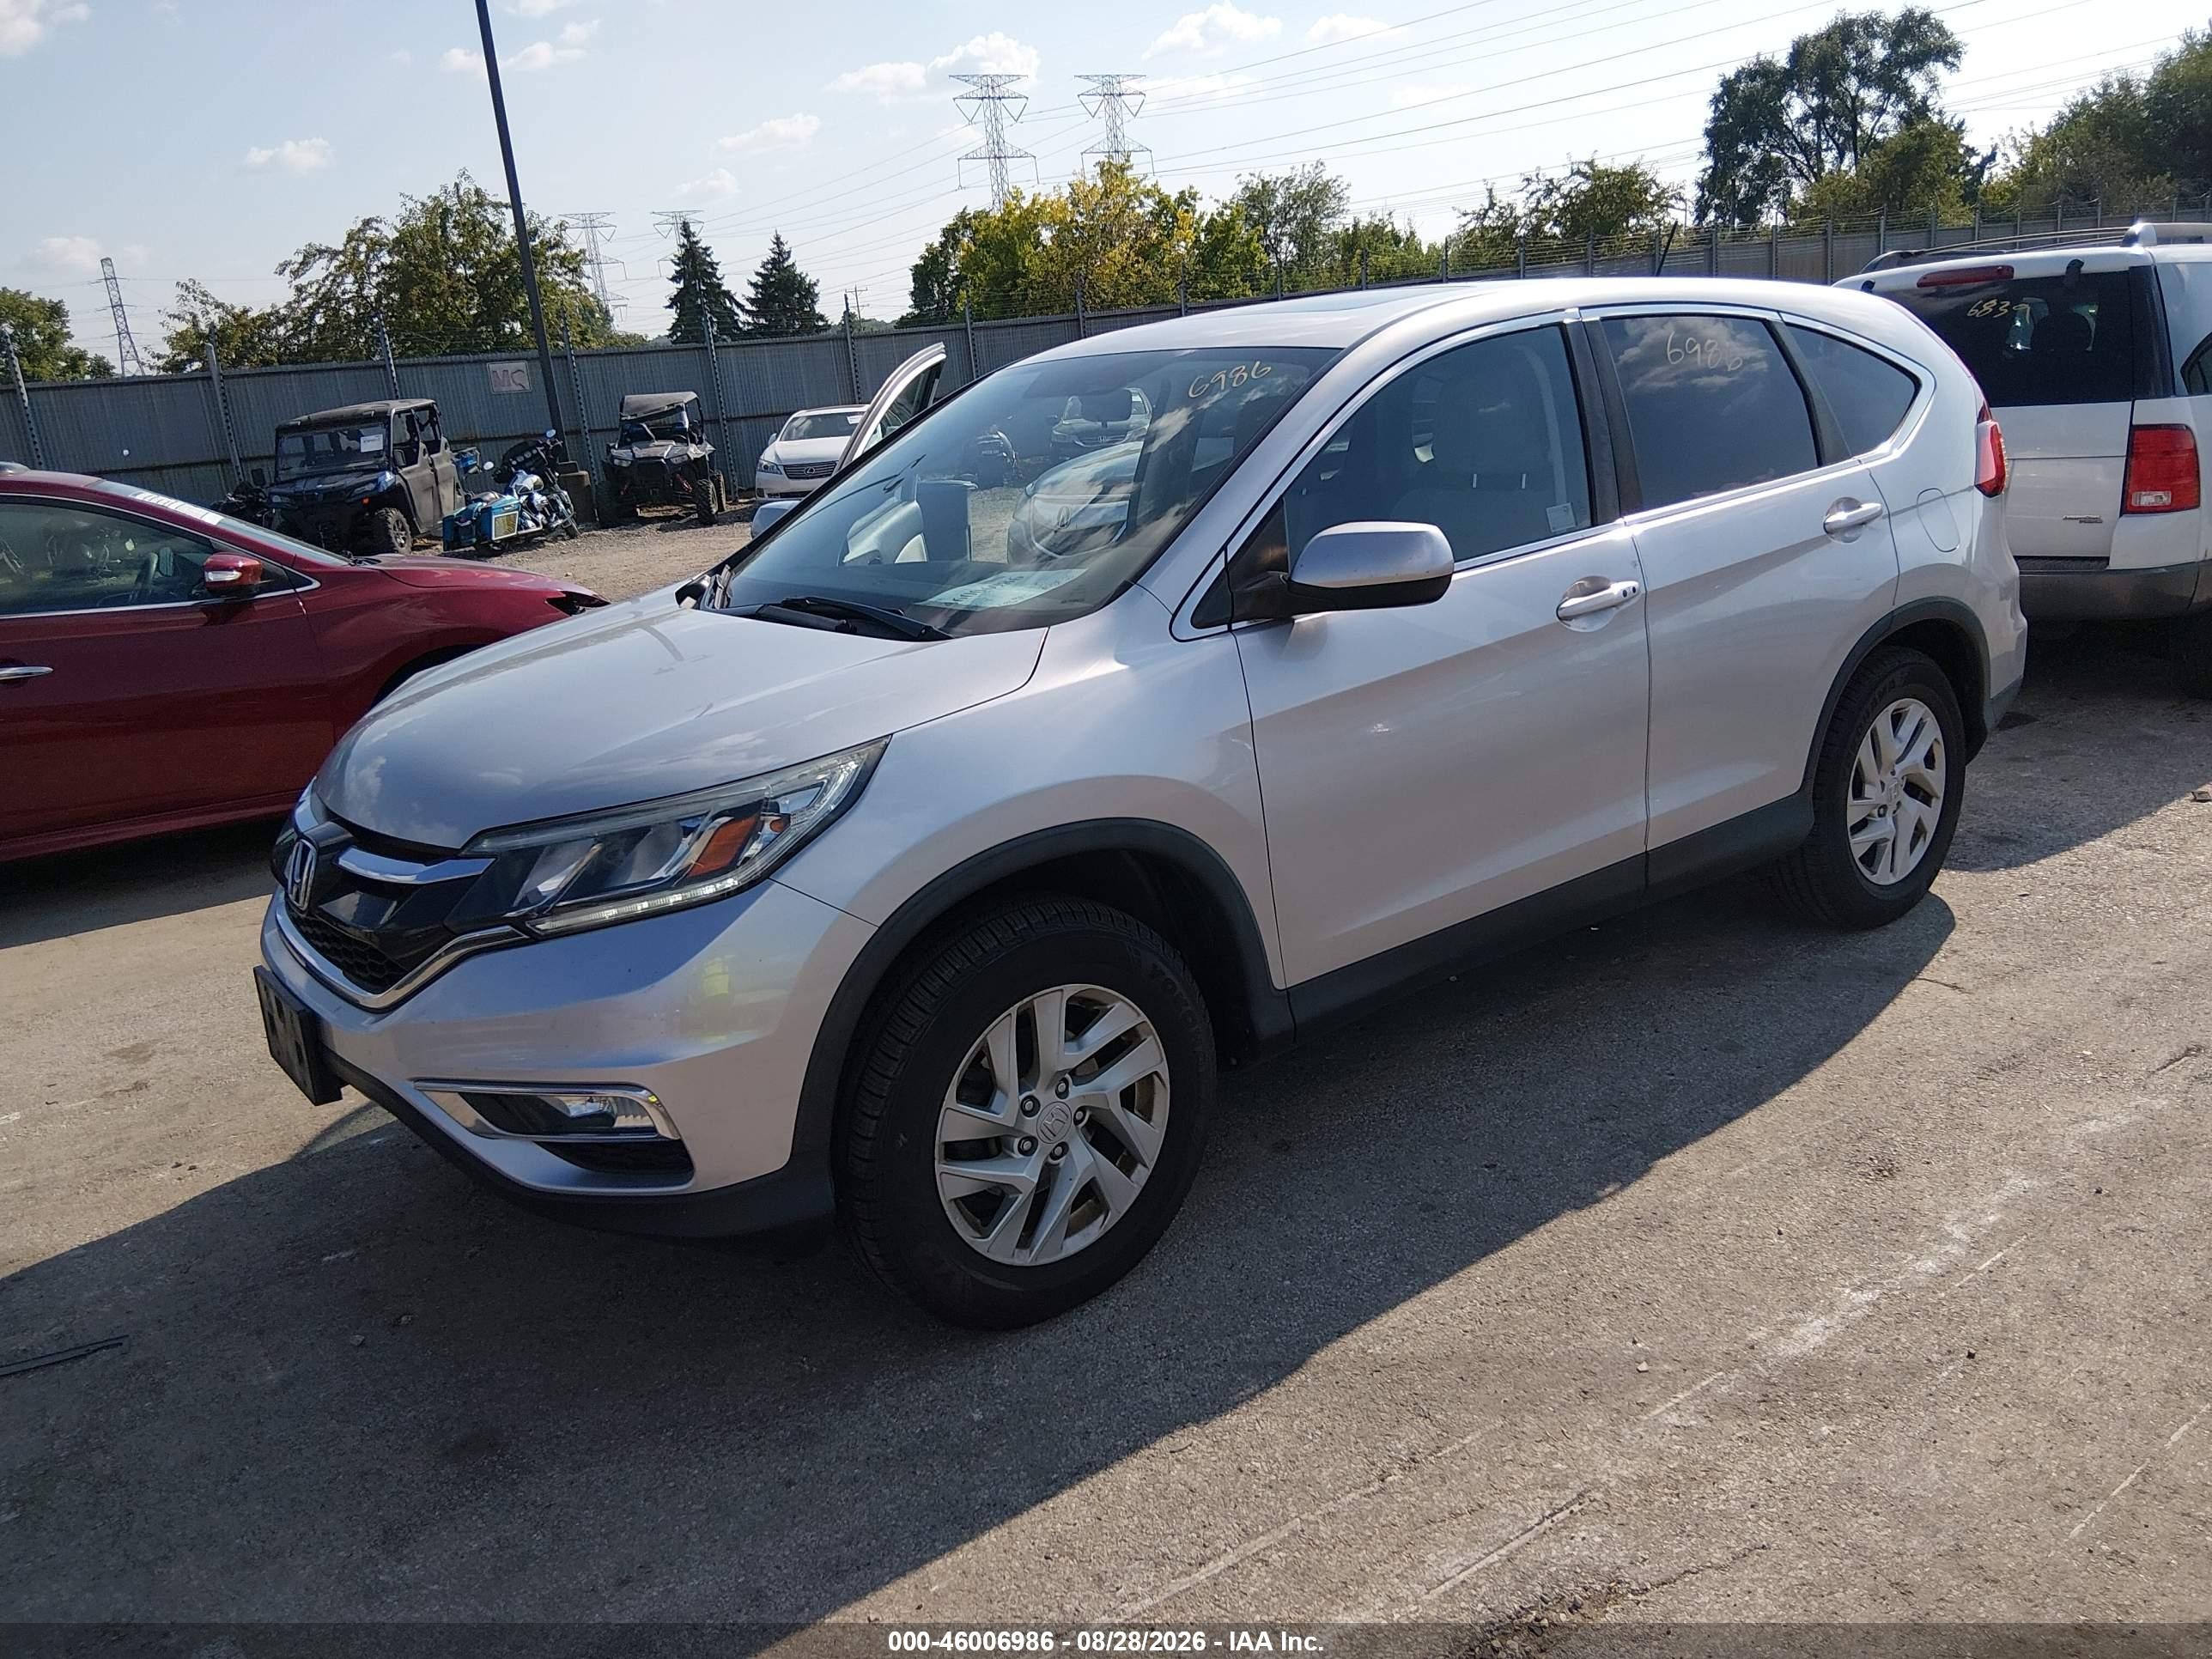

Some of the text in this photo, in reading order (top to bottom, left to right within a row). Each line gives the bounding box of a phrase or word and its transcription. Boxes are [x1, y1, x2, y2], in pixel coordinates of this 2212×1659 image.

[1966, 299, 2032, 324] 6839
[1667, 331, 1743, 372] 6986
[1188, 361, 1272, 398] 6986
